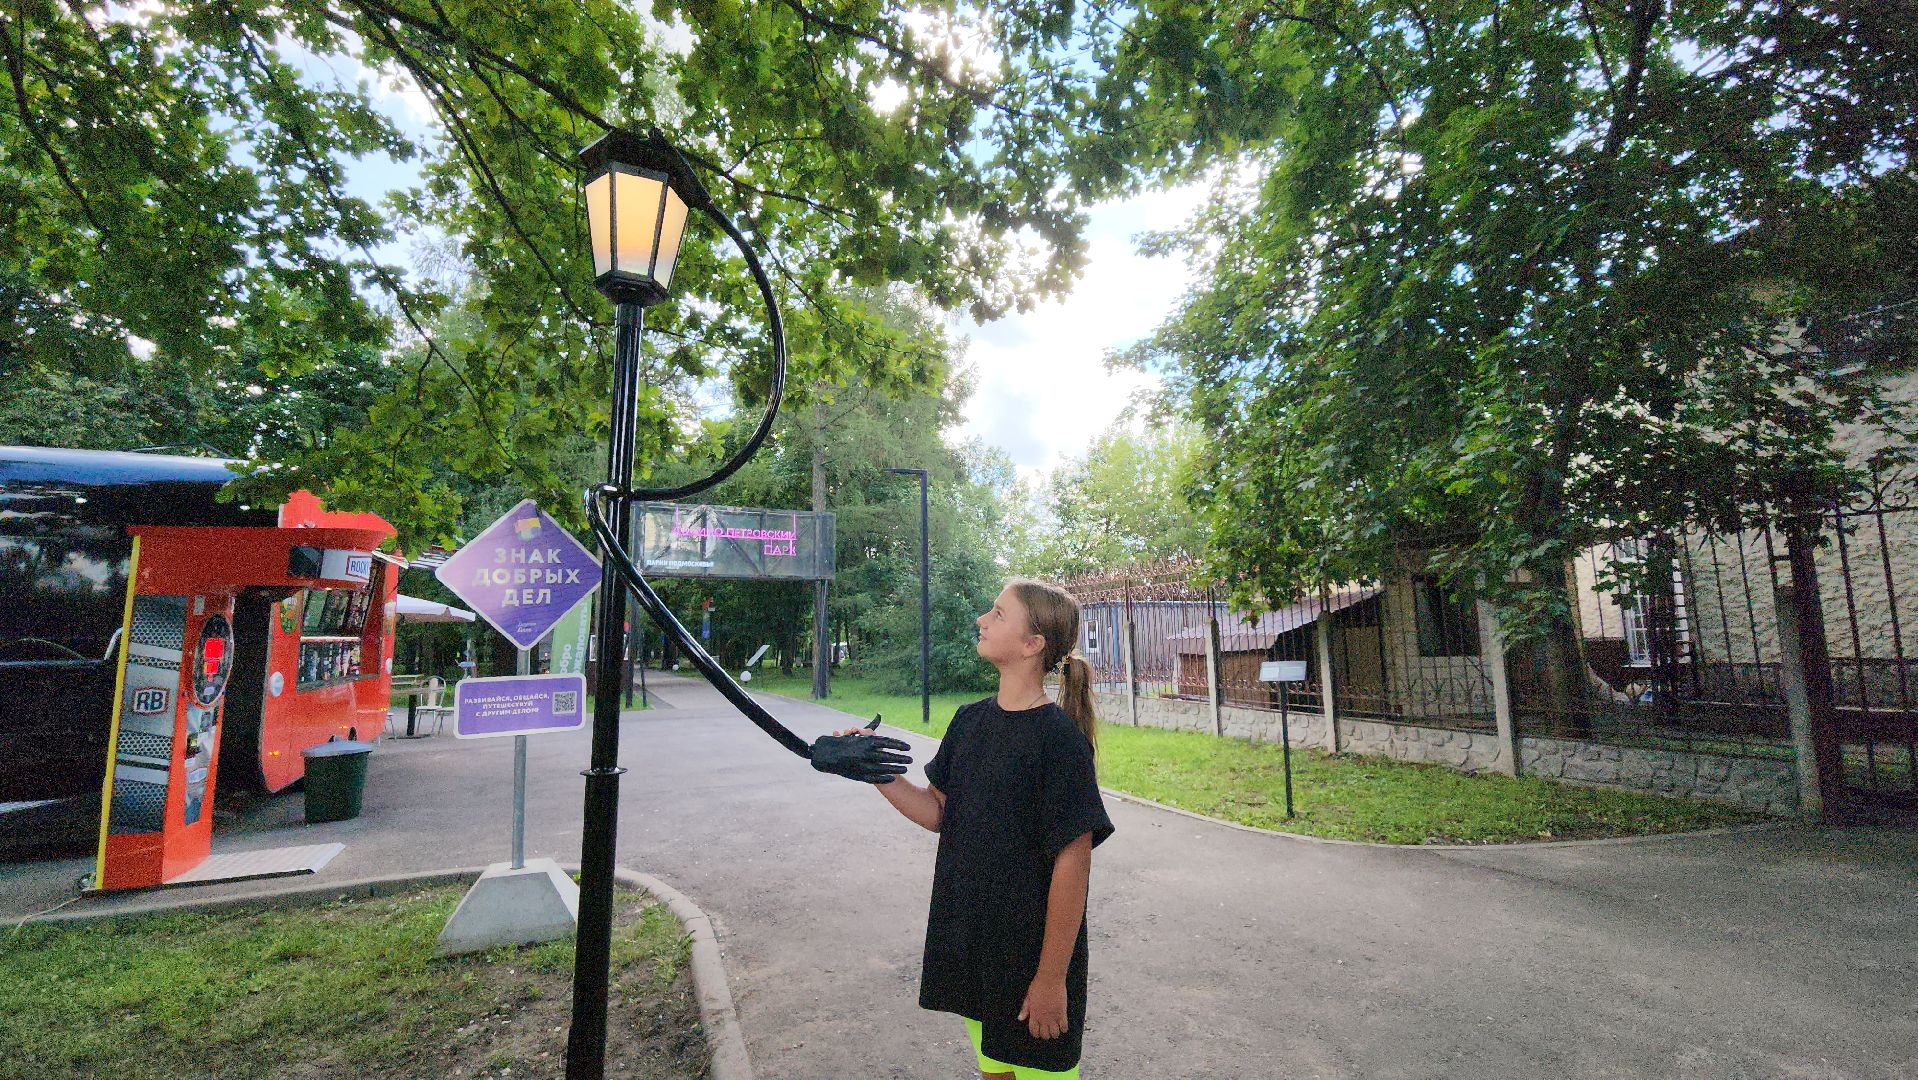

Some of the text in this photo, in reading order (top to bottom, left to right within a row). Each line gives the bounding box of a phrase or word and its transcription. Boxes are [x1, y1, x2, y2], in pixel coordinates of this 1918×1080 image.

[494, 548, 562, 564] ЗНАК
[764, 543, 797, 556] ПАРК
[472, 568, 580, 586] ДОБРЫХ
[502, 588, 551, 607] ДЕЛ
[560, 643, 572, 675] обро
[137, 691, 163, 710] RB
